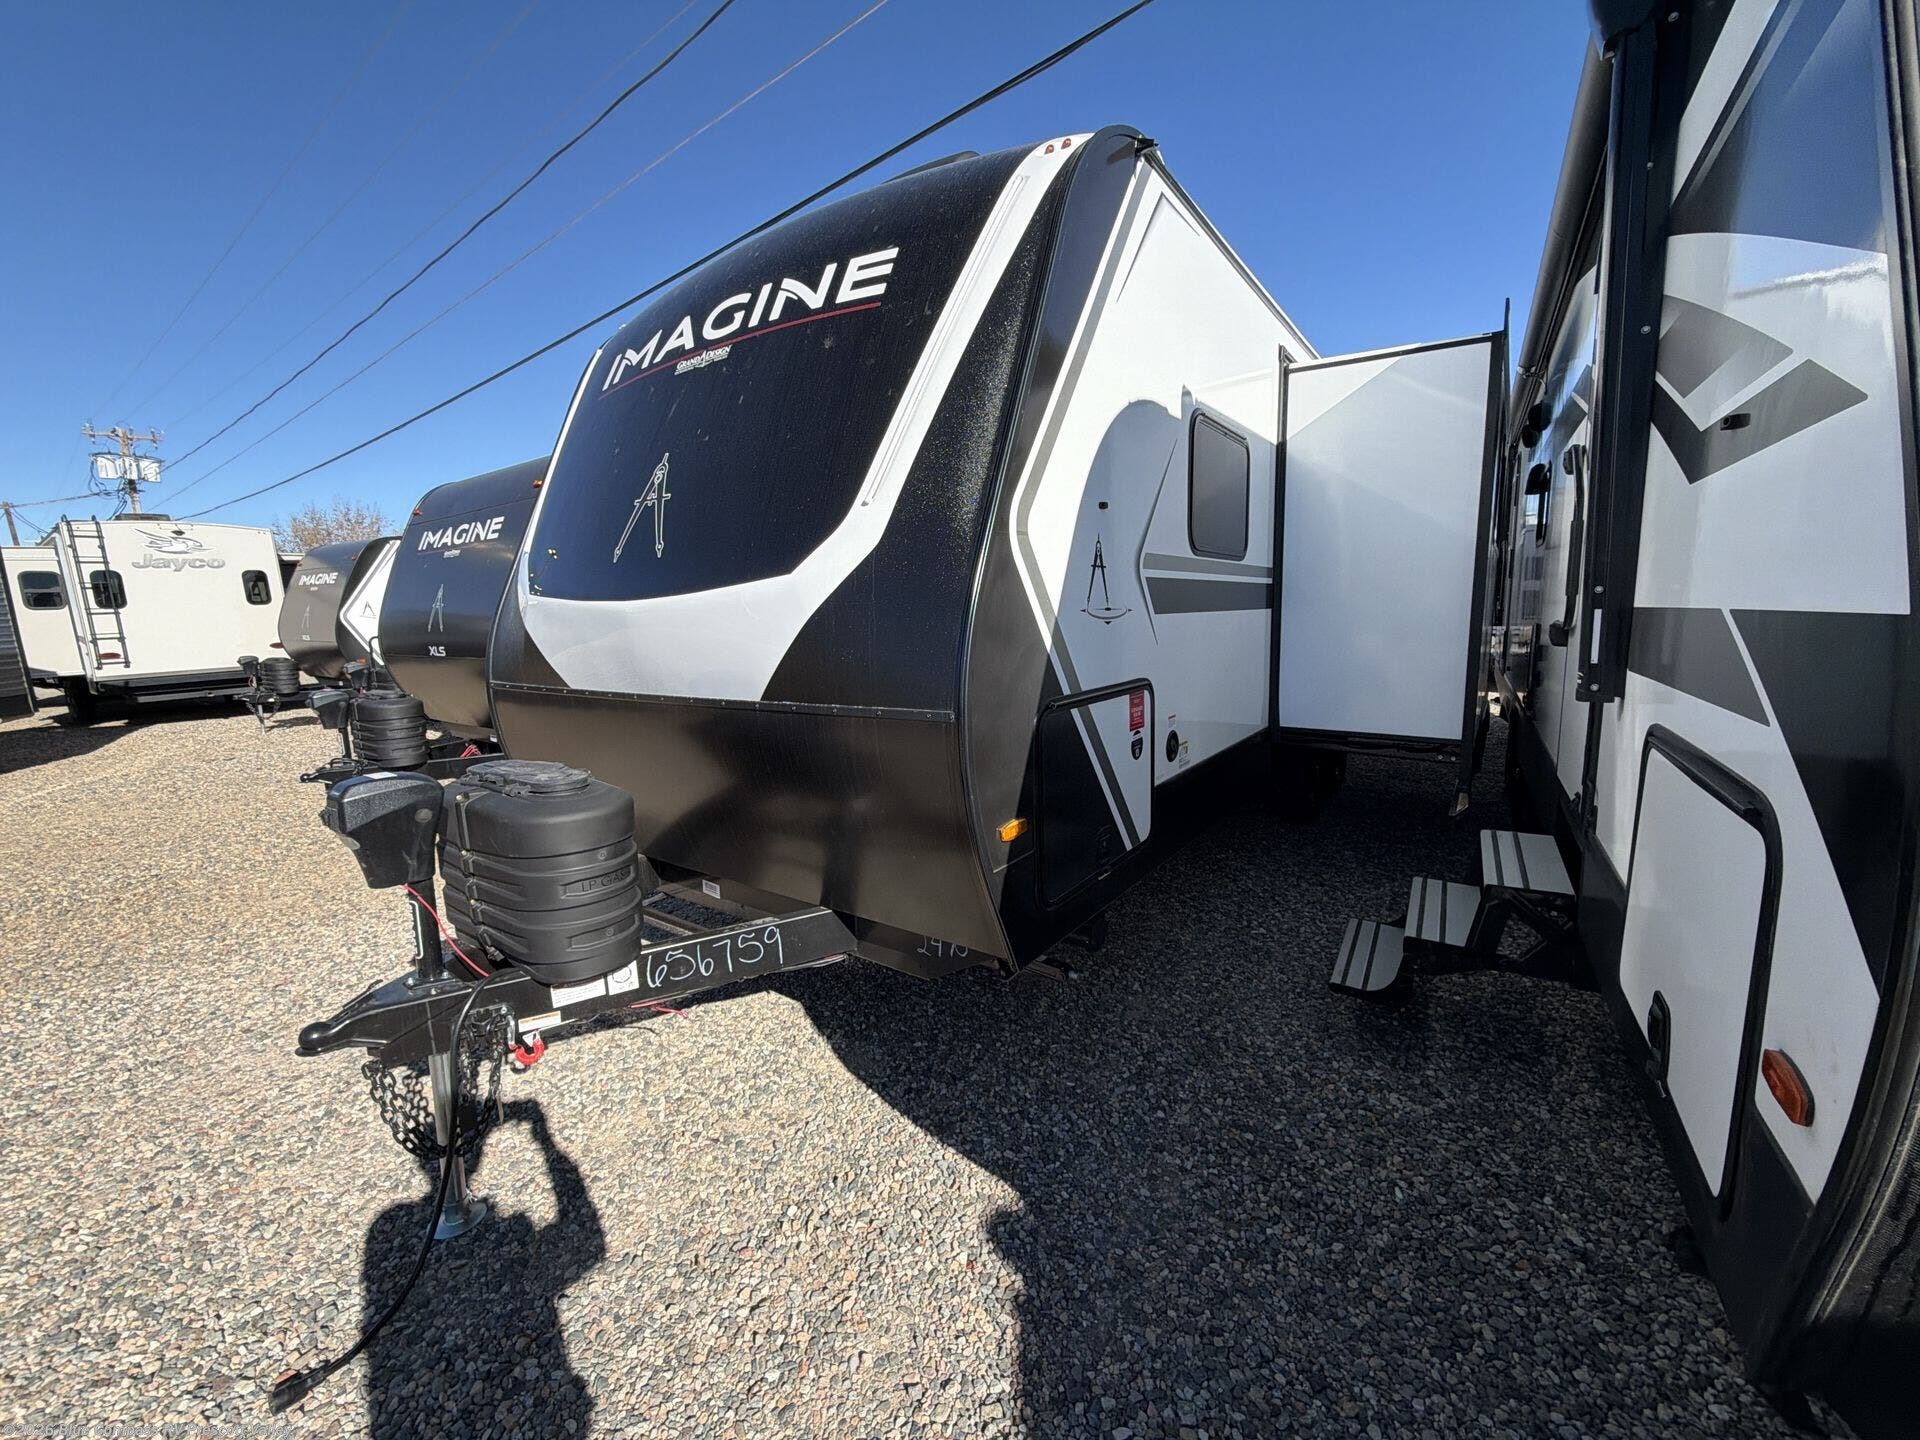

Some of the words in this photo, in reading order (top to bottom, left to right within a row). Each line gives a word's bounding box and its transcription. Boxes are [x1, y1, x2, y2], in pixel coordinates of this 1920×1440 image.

[602, 247, 899, 392] IMAGINE
[417, 516, 505, 551] IMAGINE
[131, 553, 226, 572] Jayco
[298, 572, 339, 586] IMAGINE
[428, 645, 447, 657] XLS
[581, 879, 597, 892] LP
[646, 926, 784, 988] 656759
